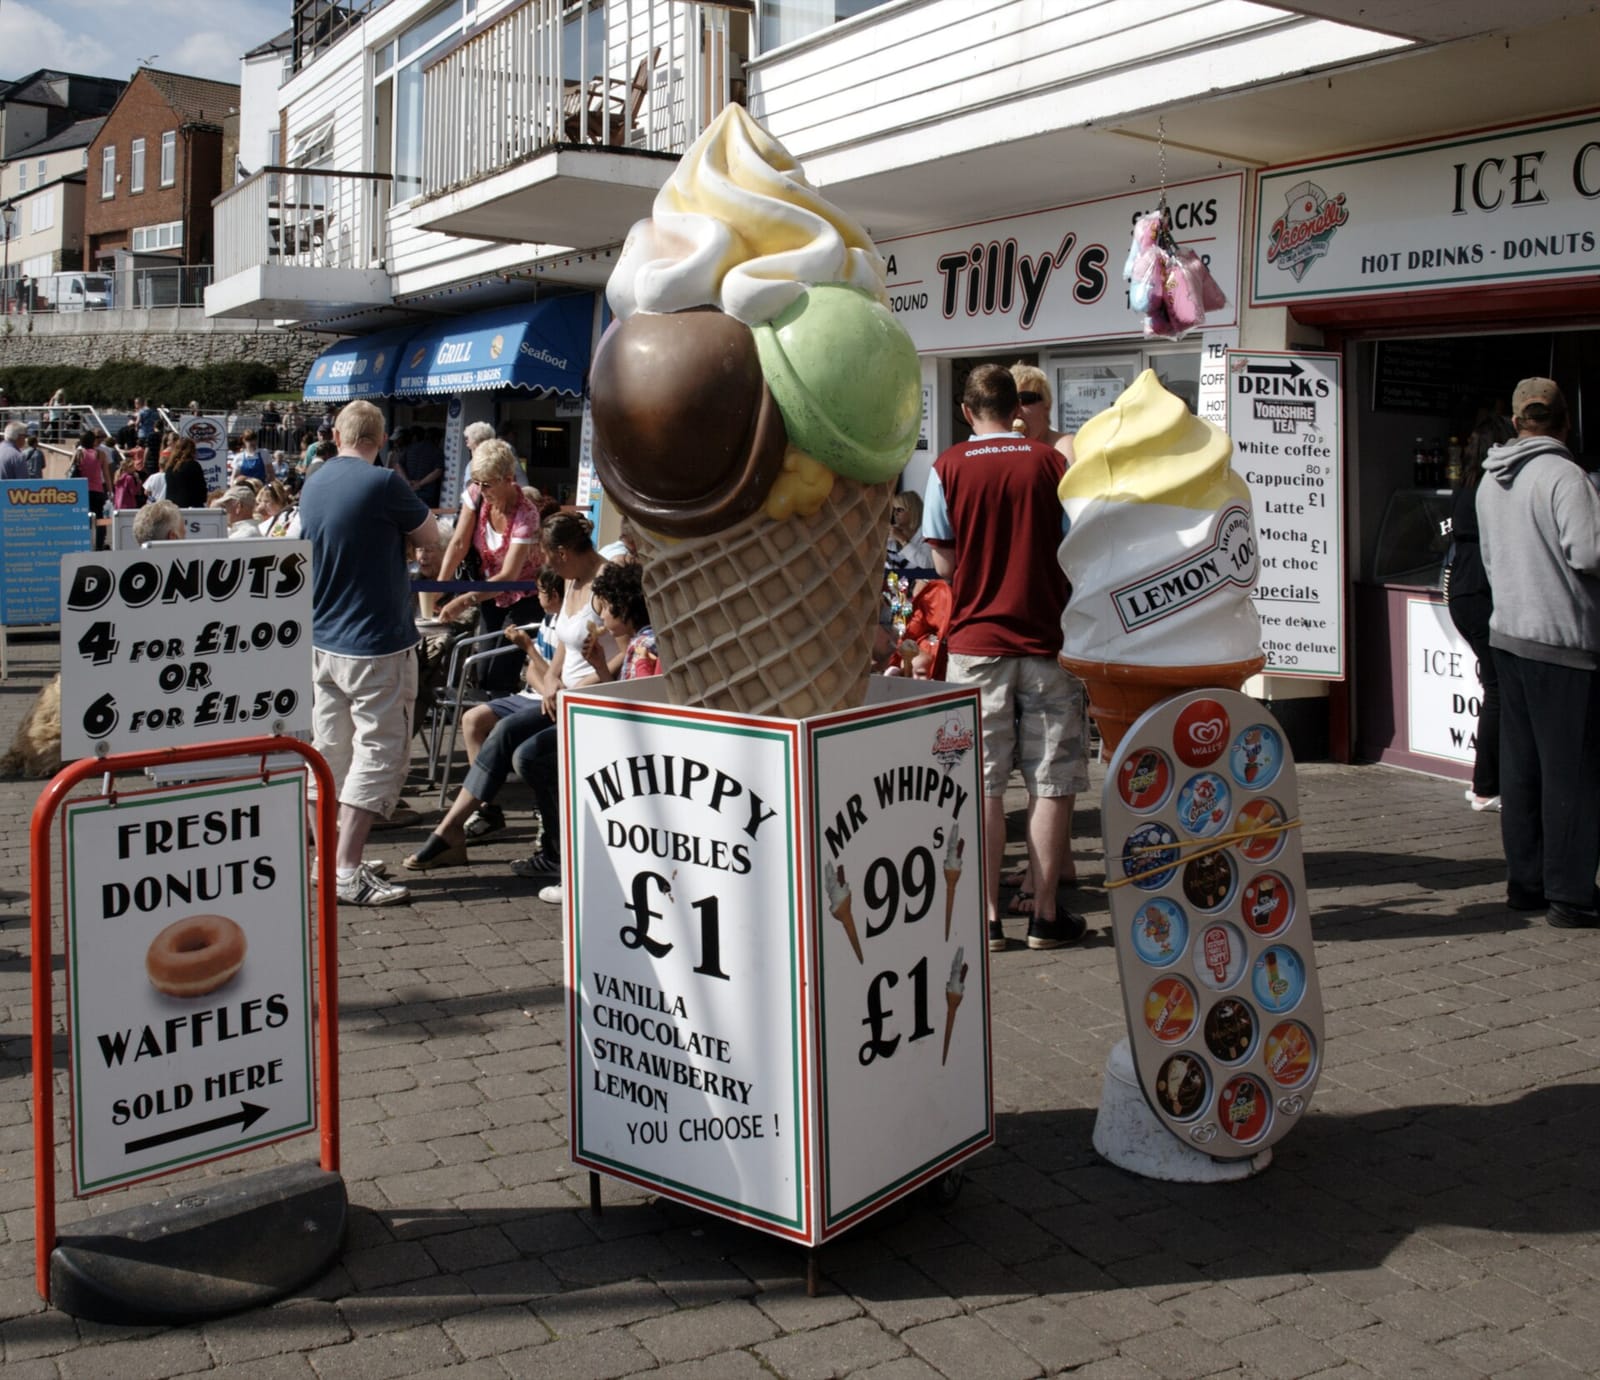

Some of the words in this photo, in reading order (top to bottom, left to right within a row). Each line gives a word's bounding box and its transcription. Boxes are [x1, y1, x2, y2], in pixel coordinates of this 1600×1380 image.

[1451, 151, 1549, 216] ICE
[1267, 192, 1350, 264] Jaconelli
[1361, 252, 1401, 274] HOT
[1408, 244, 1483, 270] DRINKS
[1503, 231, 1595, 261] DONUTS
[937, 232, 1108, 330] Tilly's
[437, 341, 472, 365] GRILL
[520, 342, 567, 370] Seafood
[1238, 375, 1329, 398] DRINKS
[1255, 401, 1314, 420] YORKSHIRE
[1274, 419, 1295, 432] TEA
[965, 445, 1032, 457] cooke.co.uk
[1238, 441, 1279, 455] White
[1284, 444, 1331, 457] coffee
[7, 487, 78, 505] Waffles
[1246, 471, 1324, 487] Cappucino
[1265, 501, 1304, 515] Latte
[1260, 528, 1307, 542] Mocha
[67, 552, 308, 612] DONUTS
[1262, 557, 1277, 569] ot
[1282, 557, 1318, 570] choc
[1128, 558, 1221, 618] LEMON
[78, 621, 120, 666] 4
[129, 638, 184, 663] FOR
[193, 619, 301, 655] £1.00
[1262, 640, 1291, 651] choc
[1296, 642, 1336, 654] deluxe
[1423, 648, 1464, 678] ICE
[158, 662, 212, 694] OR
[83, 692, 119, 739] 6
[129, 707, 184, 732] FOR
[193, 688, 298, 727] £1.50
[585, 754, 778, 842] WHIPPY
[824, 793, 869, 859] MR
[874, 766, 968, 820] WHIPPY
[117, 805, 260, 859] FRESH
[607, 819, 752, 875] DOUBLES
[101, 856, 276, 919] DONUTS
[620, 871, 731, 981] £1
[593, 972, 688, 1019] VANILLA
[858, 956, 935, 1066] £1
[97, 994, 289, 1069] WAFFLES
[593, 1004, 731, 1064] CHOCOLATE
[111, 1083, 193, 1126] SOLD
[204, 1059, 284, 1102] HERE
[593, 1038, 753, 1105] STRAWBERRY
[593, 1069, 668, 1113] LEMON
[627, 1121, 668, 1145] YOU
[679, 1115, 764, 1142] CHOOSE
